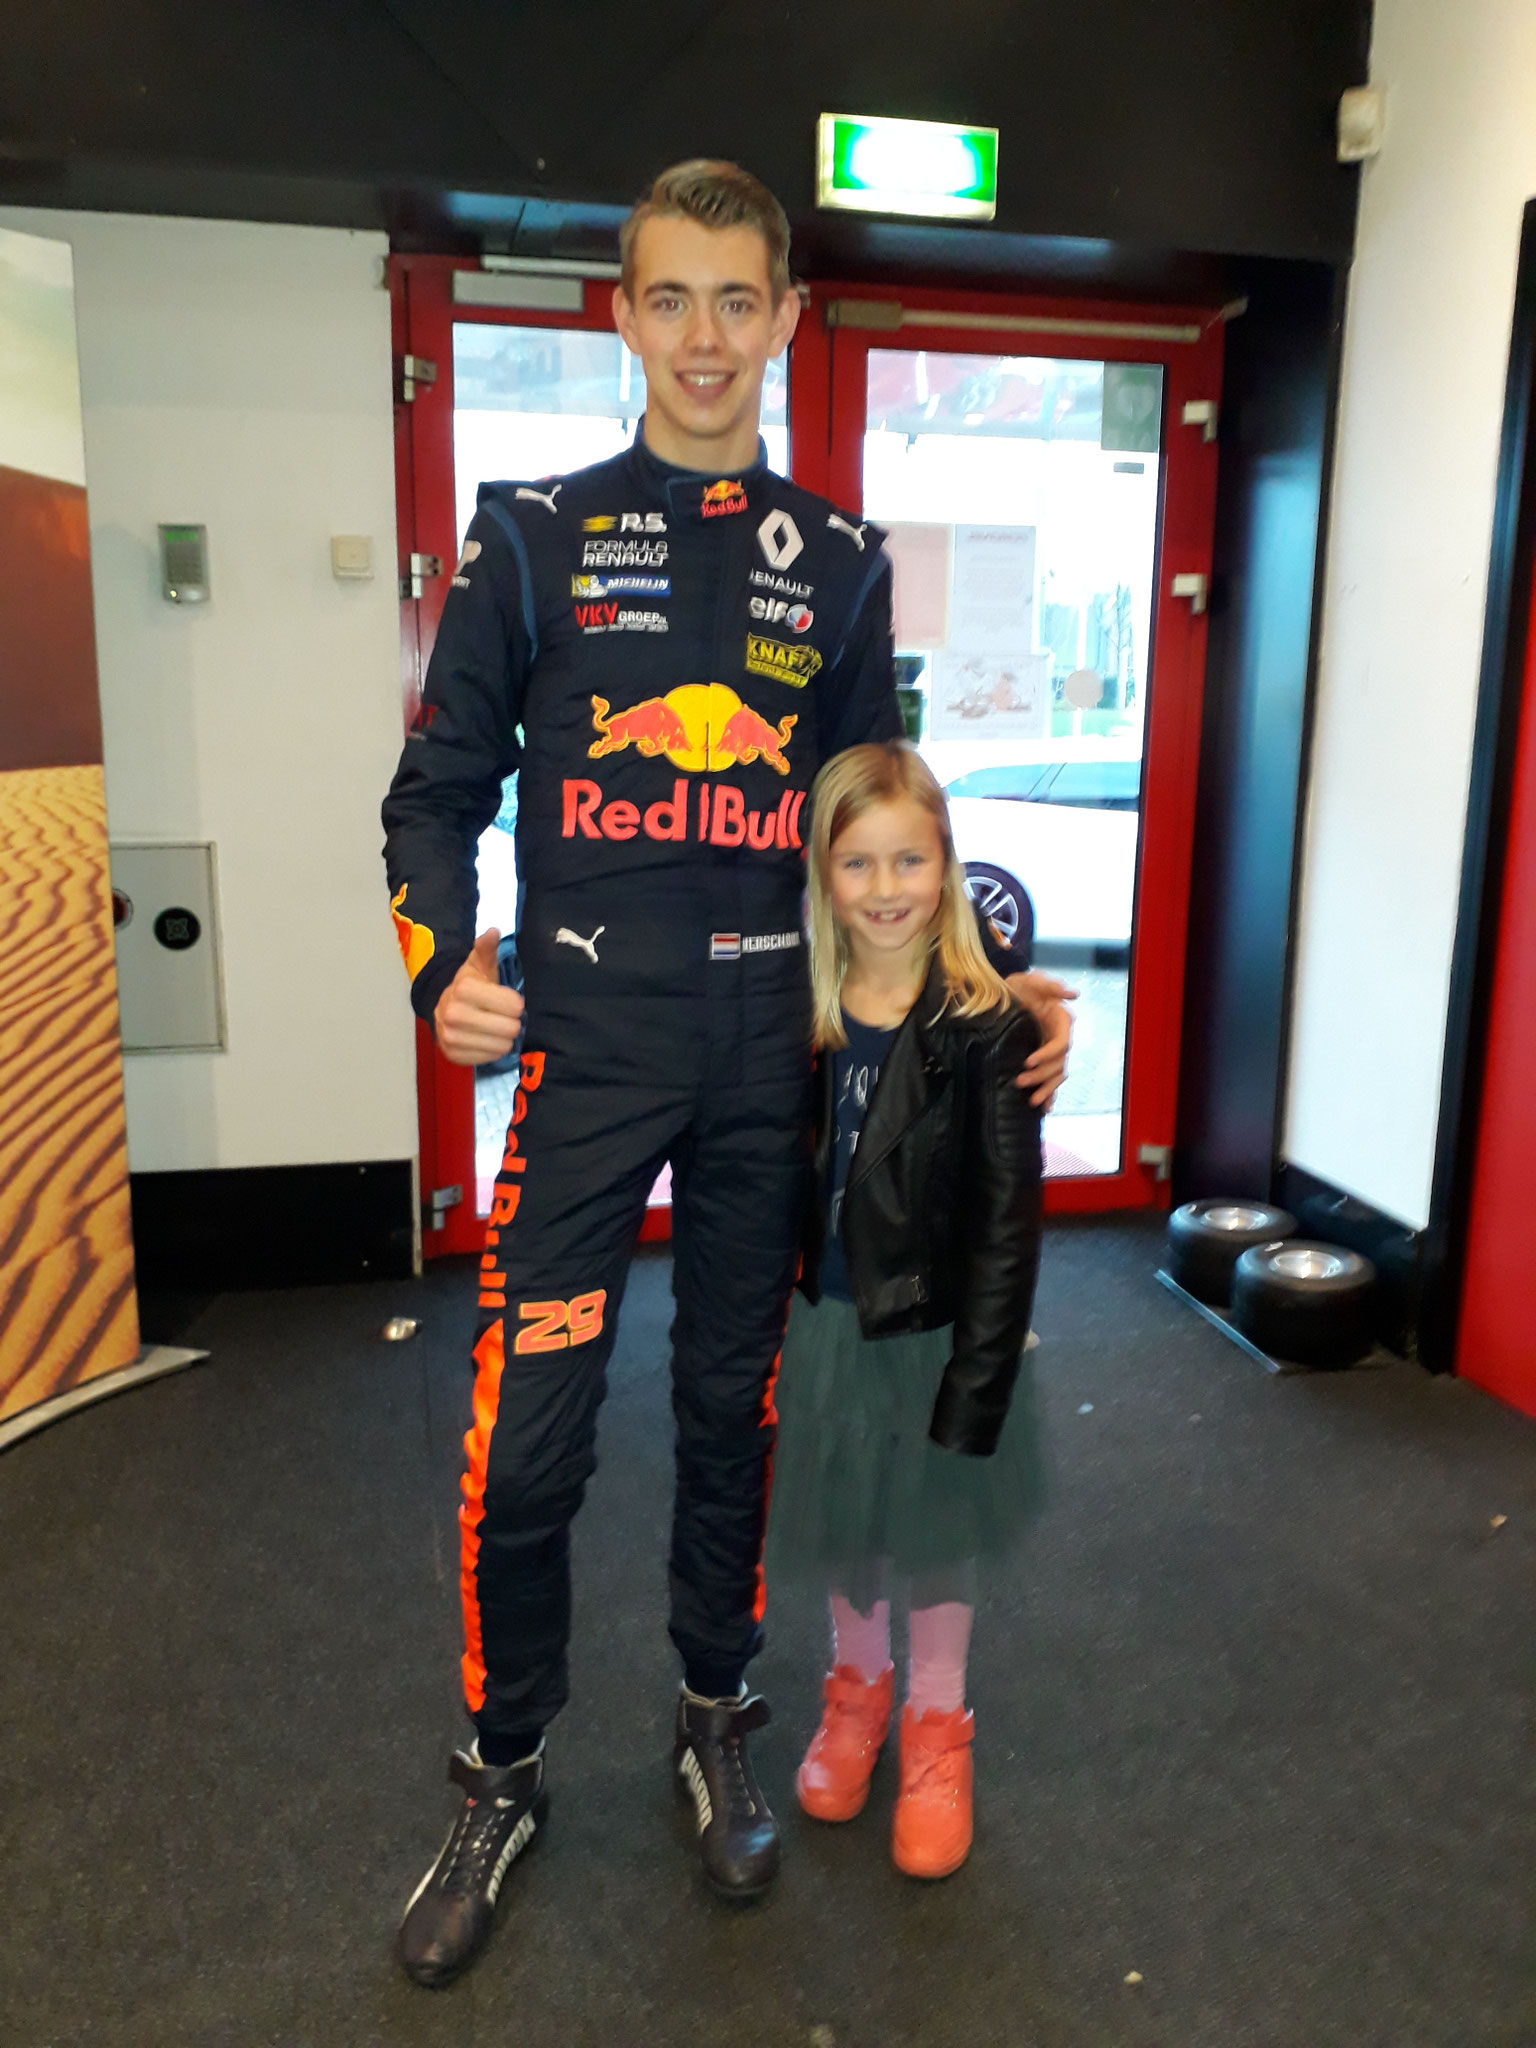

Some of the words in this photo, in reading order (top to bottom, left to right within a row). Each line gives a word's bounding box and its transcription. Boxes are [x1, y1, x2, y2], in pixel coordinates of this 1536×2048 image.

[726, 494, 748, 514] Bull
[584, 540, 668, 553] FORMULA
[582, 552, 669, 567] RENAULT
[606, 577, 669, 591] MICHELIN
[574, 602, 618, 628] VKV
[561, 778, 689, 840] Red
[698, 783, 807, 851] Bull
[514, 1288, 607, 1356] 29
